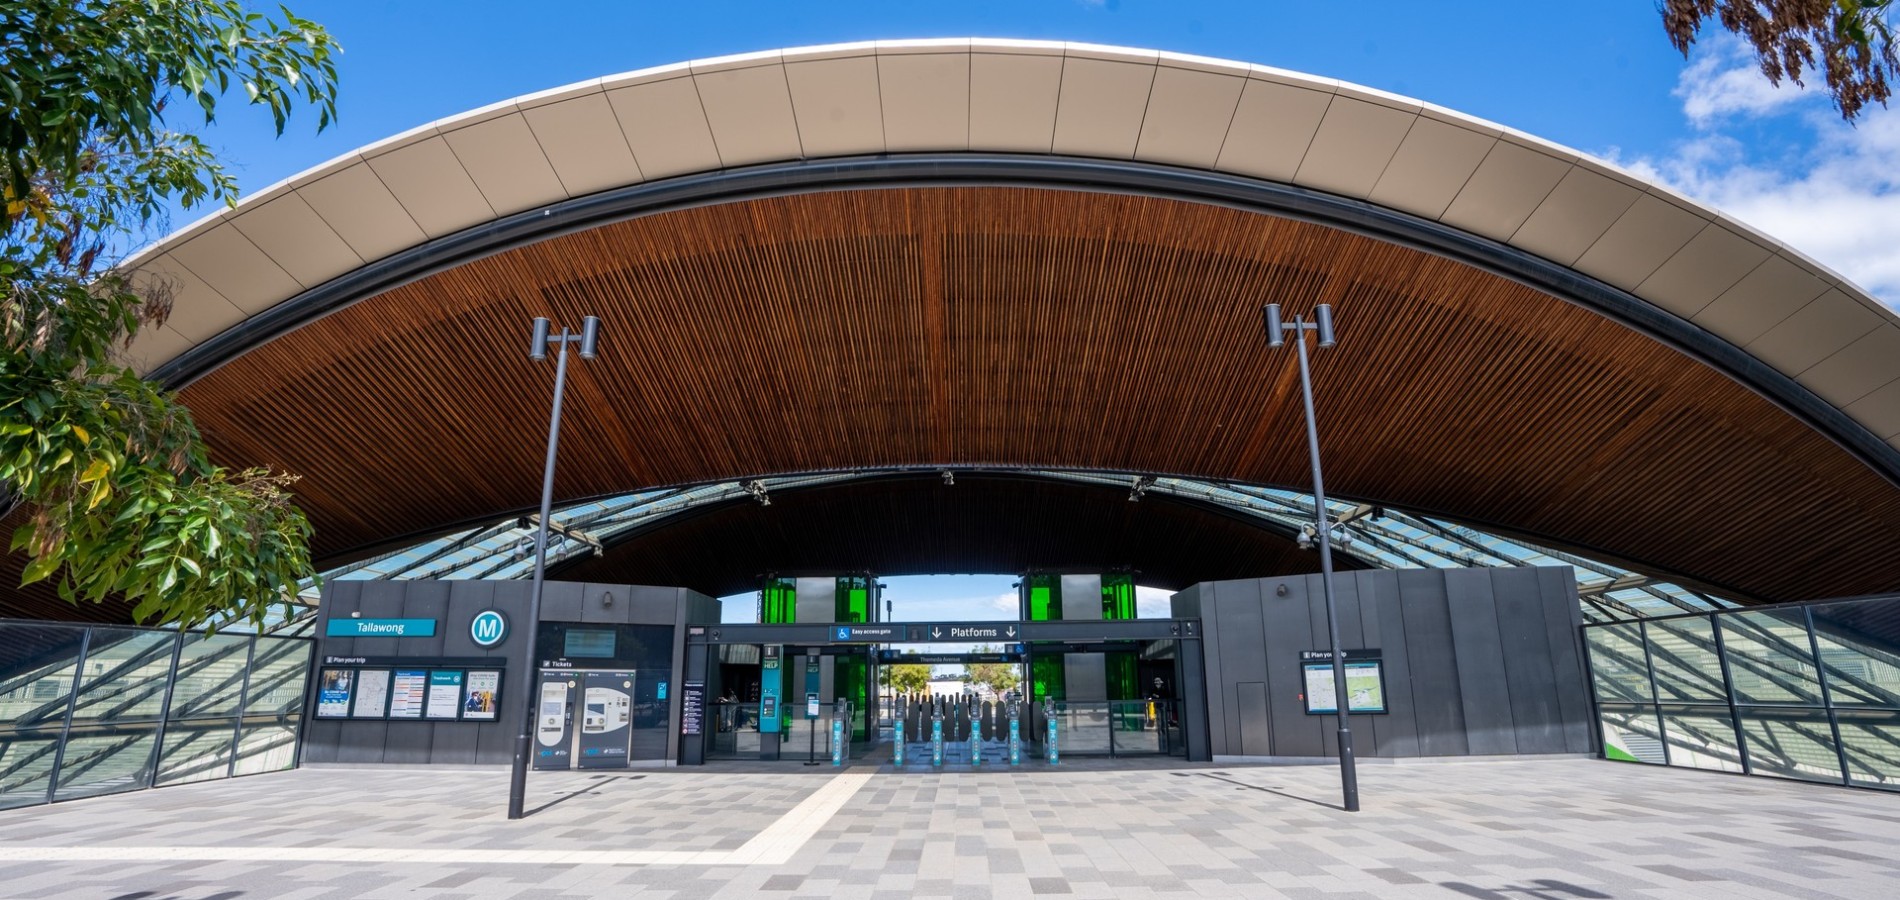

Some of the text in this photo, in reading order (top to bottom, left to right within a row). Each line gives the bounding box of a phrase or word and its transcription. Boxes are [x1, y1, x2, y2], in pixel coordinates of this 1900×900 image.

[357, 622, 405, 635] Tallawong
[478, 619, 497, 637] M
[852, 628, 863, 636] Easy
[880, 628, 892, 636] gate
[951, 627, 997, 638] Platforms
[333, 656, 345, 664] Plan
[356, 656, 366, 665] trip
